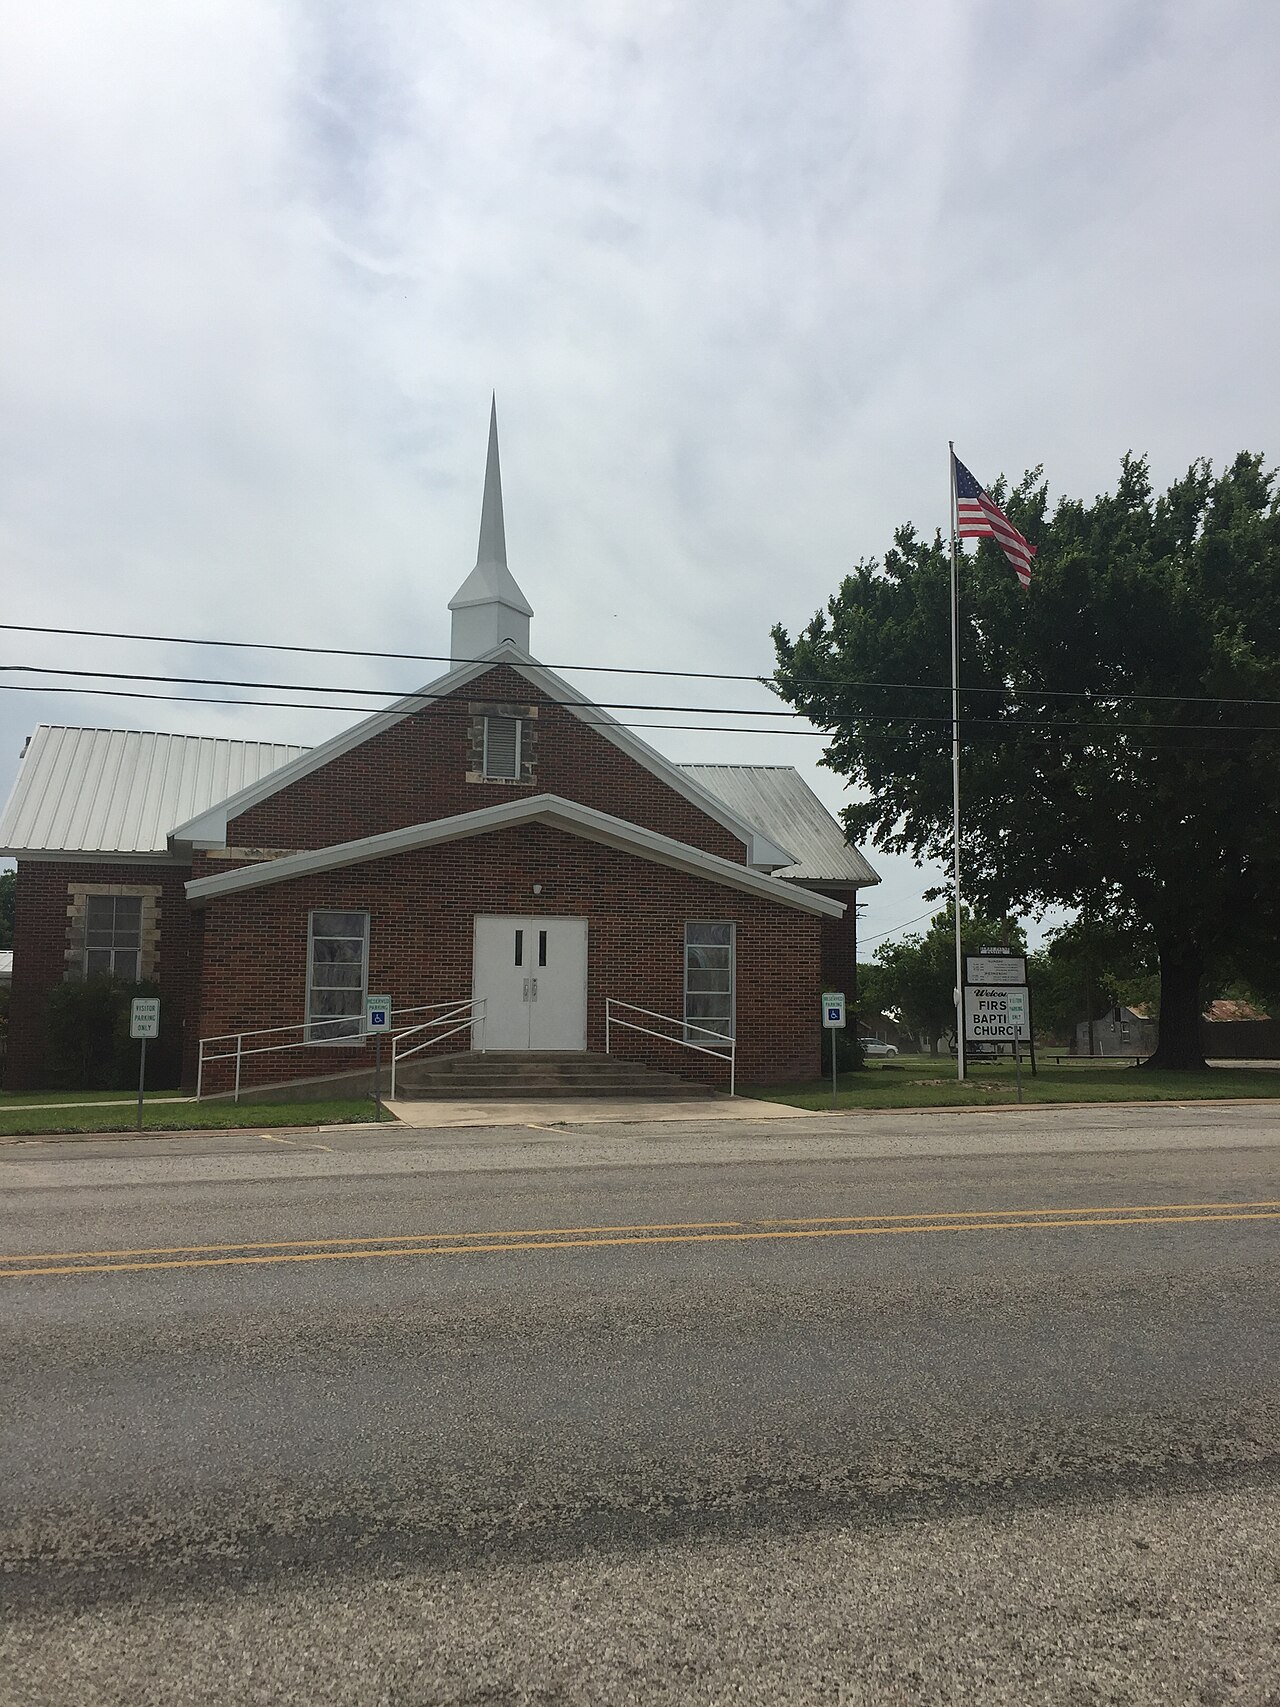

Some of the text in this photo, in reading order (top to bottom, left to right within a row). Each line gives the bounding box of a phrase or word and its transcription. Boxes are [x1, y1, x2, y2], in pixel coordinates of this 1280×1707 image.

[973, 989, 1007, 997] Welco
[979, 1001, 1007, 1010] FIRS
[973, 1014, 1007, 1023] BAPTI
[973, 1026, 1021, 1035] CHURCH
